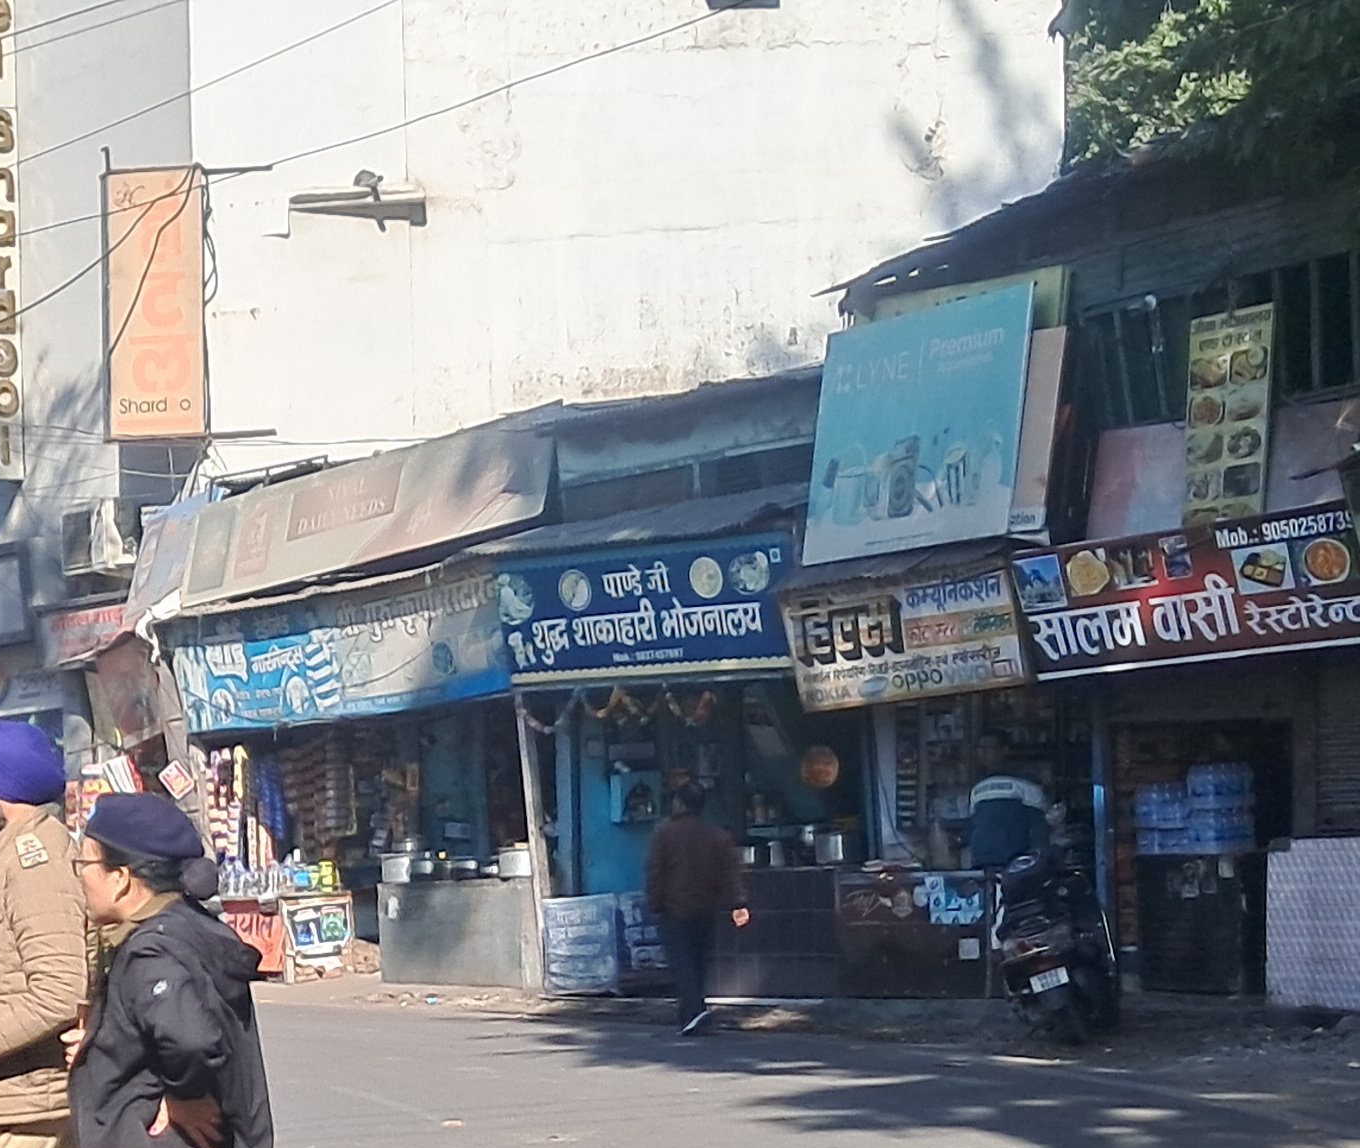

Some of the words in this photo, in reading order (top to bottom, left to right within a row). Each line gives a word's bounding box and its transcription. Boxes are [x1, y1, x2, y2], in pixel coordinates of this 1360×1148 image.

[601, 564, 642, 598] पाण्डे
[644, 561, 671, 594] जी
[531, 618, 570, 666] शुद्ध
[572, 597, 658, 646] शाकाहारी
[661, 596, 764, 639] भोजनालय
[1029, 600, 1146, 662] सालम
[1148, 573, 1241, 643] वासी
